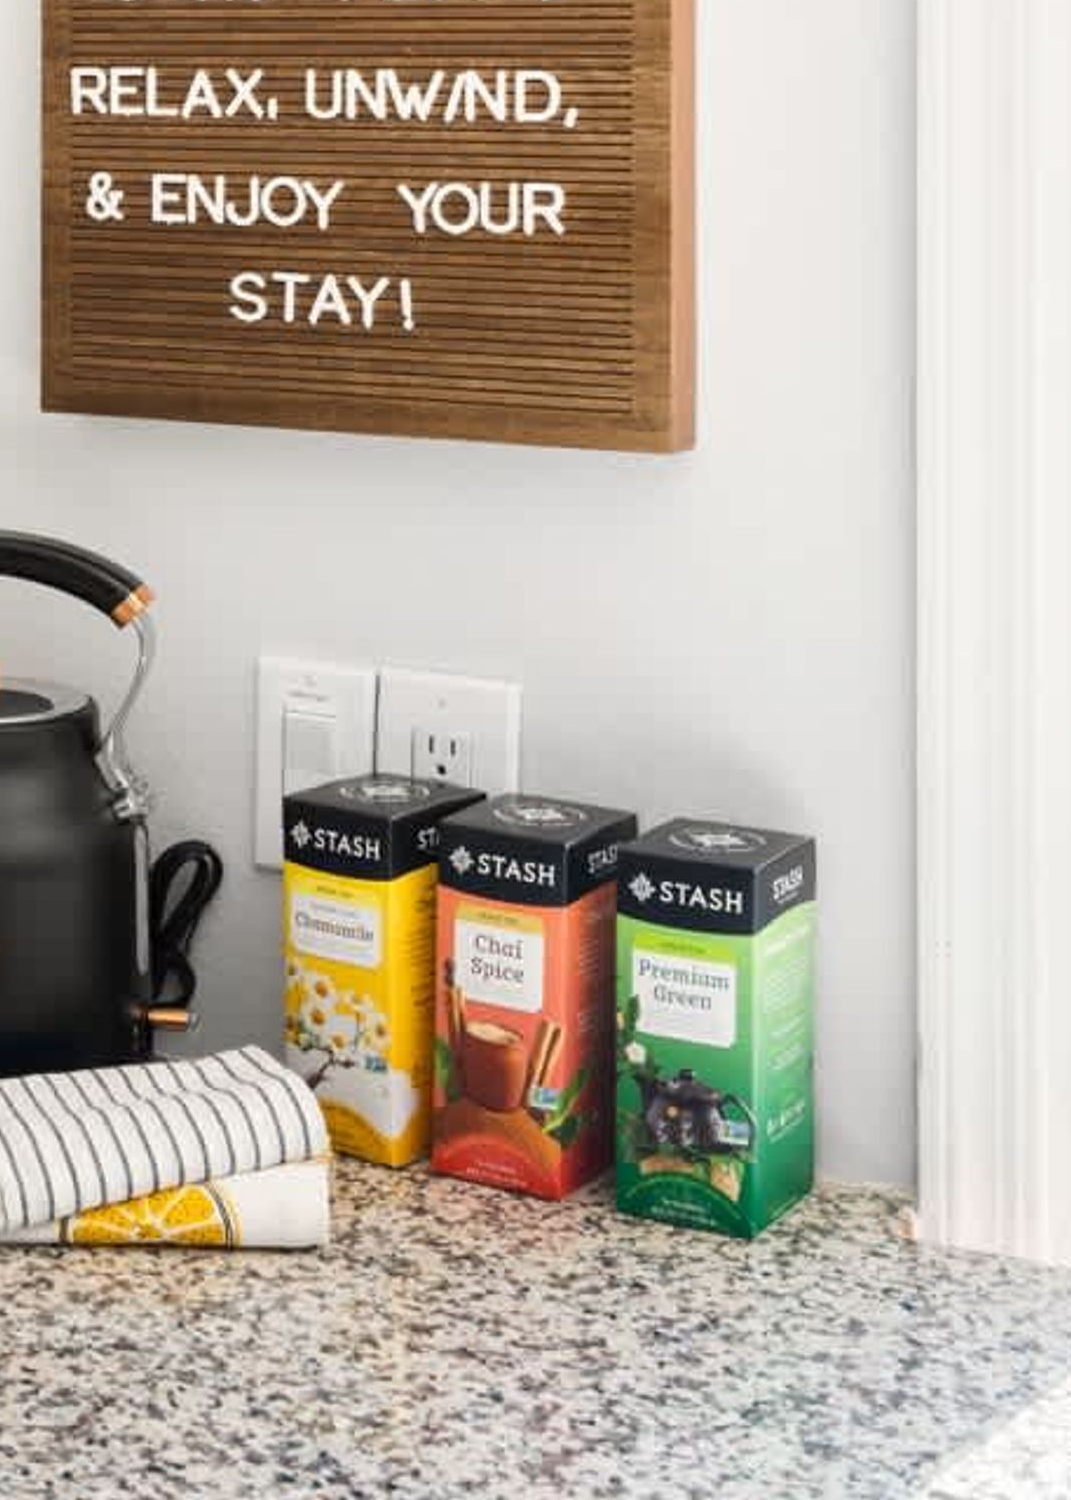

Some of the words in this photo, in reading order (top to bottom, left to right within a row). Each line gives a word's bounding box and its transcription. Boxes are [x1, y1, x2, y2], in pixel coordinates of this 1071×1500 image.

[69, 67, 278, 120] RELAX,
[305, 69, 579, 128] UNWIND,
[85, 171, 125, 221] &
[151, 173, 345, 231] ENJOY
[397, 181, 566, 236] YOUR
[229, 271, 416, 331] STAY!
[314, 829, 380, 861] STASH
[417, 826, 440, 851] ST
[477, 852, 555, 887] STASH
[659, 880, 743, 914] STASH
[474, 934, 524, 960] Chai
[470, 956, 524, 983] Spice
[639, 958, 730, 990] Premium
[653, 985, 712, 1011] Green
